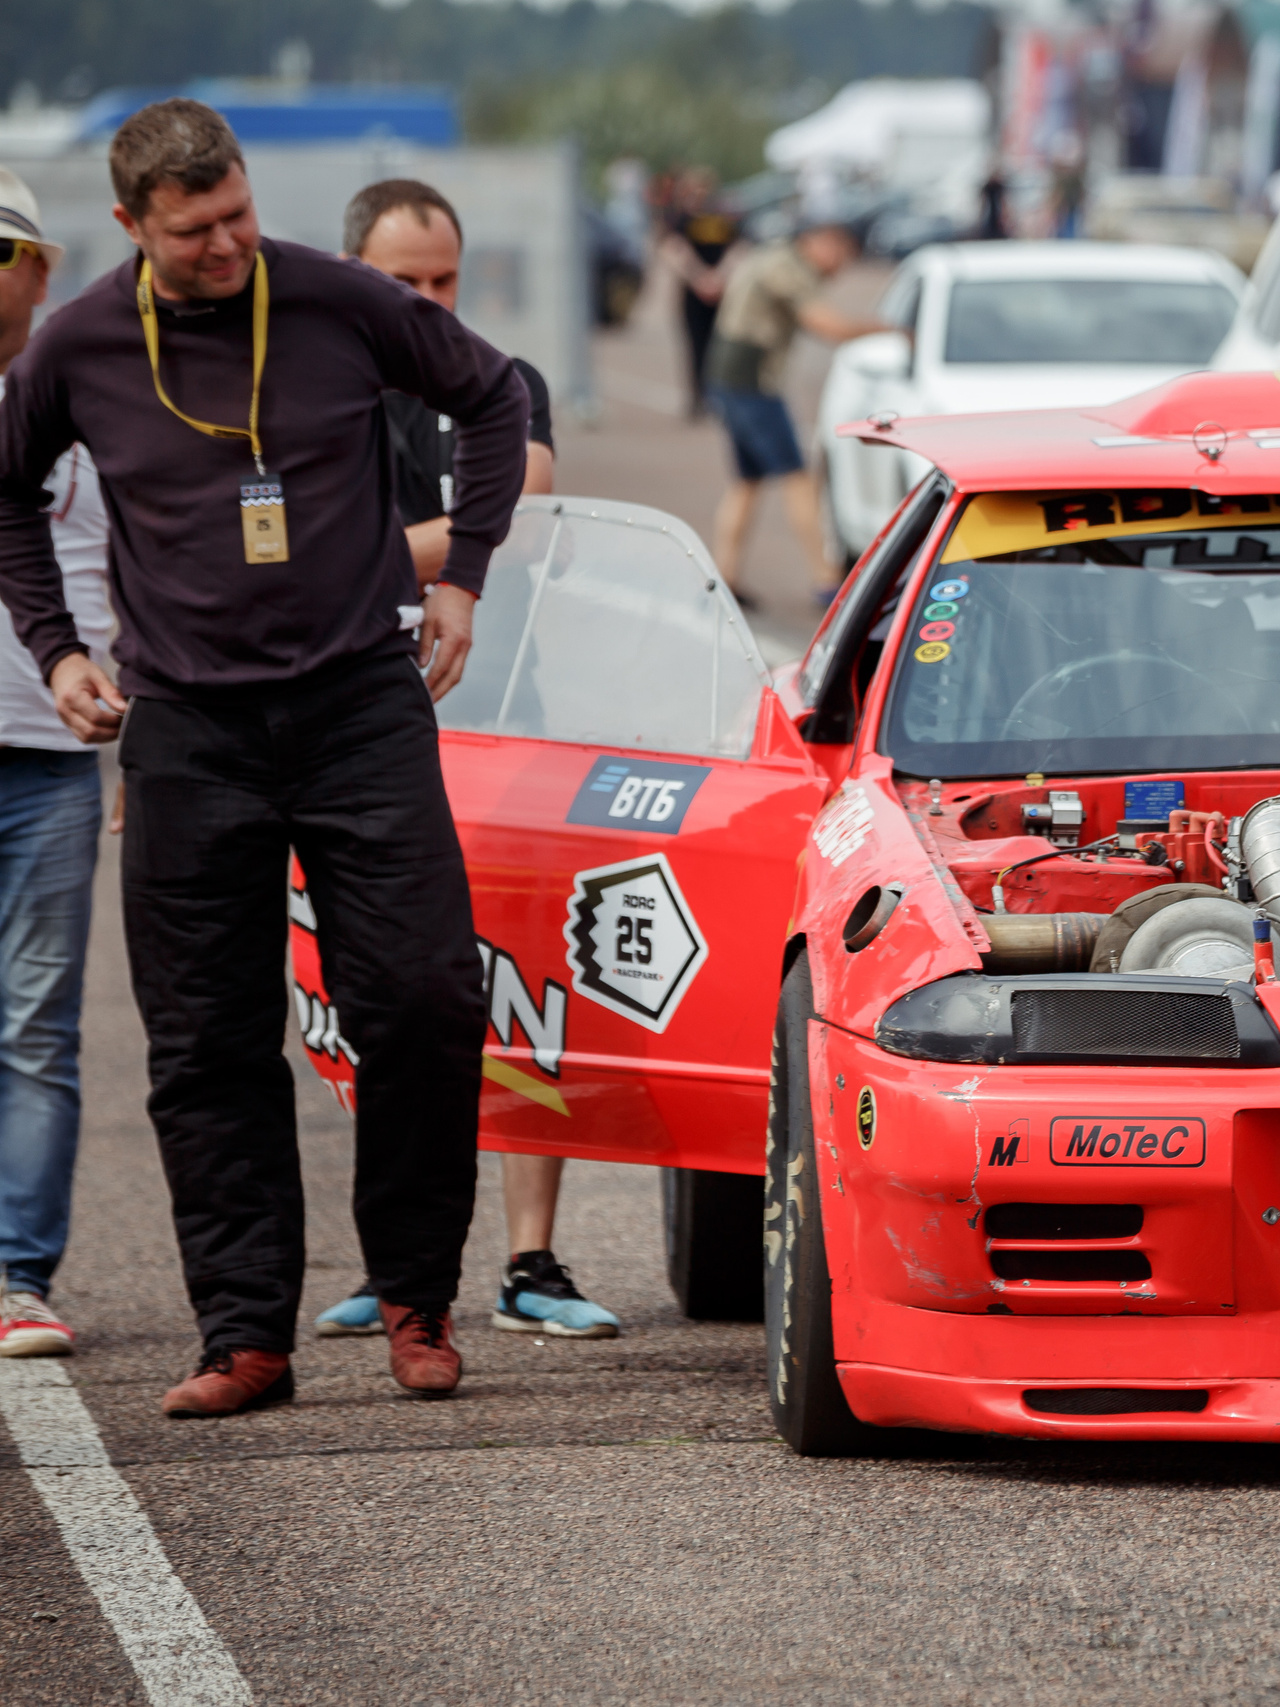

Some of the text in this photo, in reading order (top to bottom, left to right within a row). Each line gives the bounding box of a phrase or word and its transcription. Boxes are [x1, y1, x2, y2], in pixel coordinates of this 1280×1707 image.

[615, 915, 653, 965] 25
[616, 968, 659, 981] RACEPARK
[1065, 1125, 1189, 1158] MoTeC
